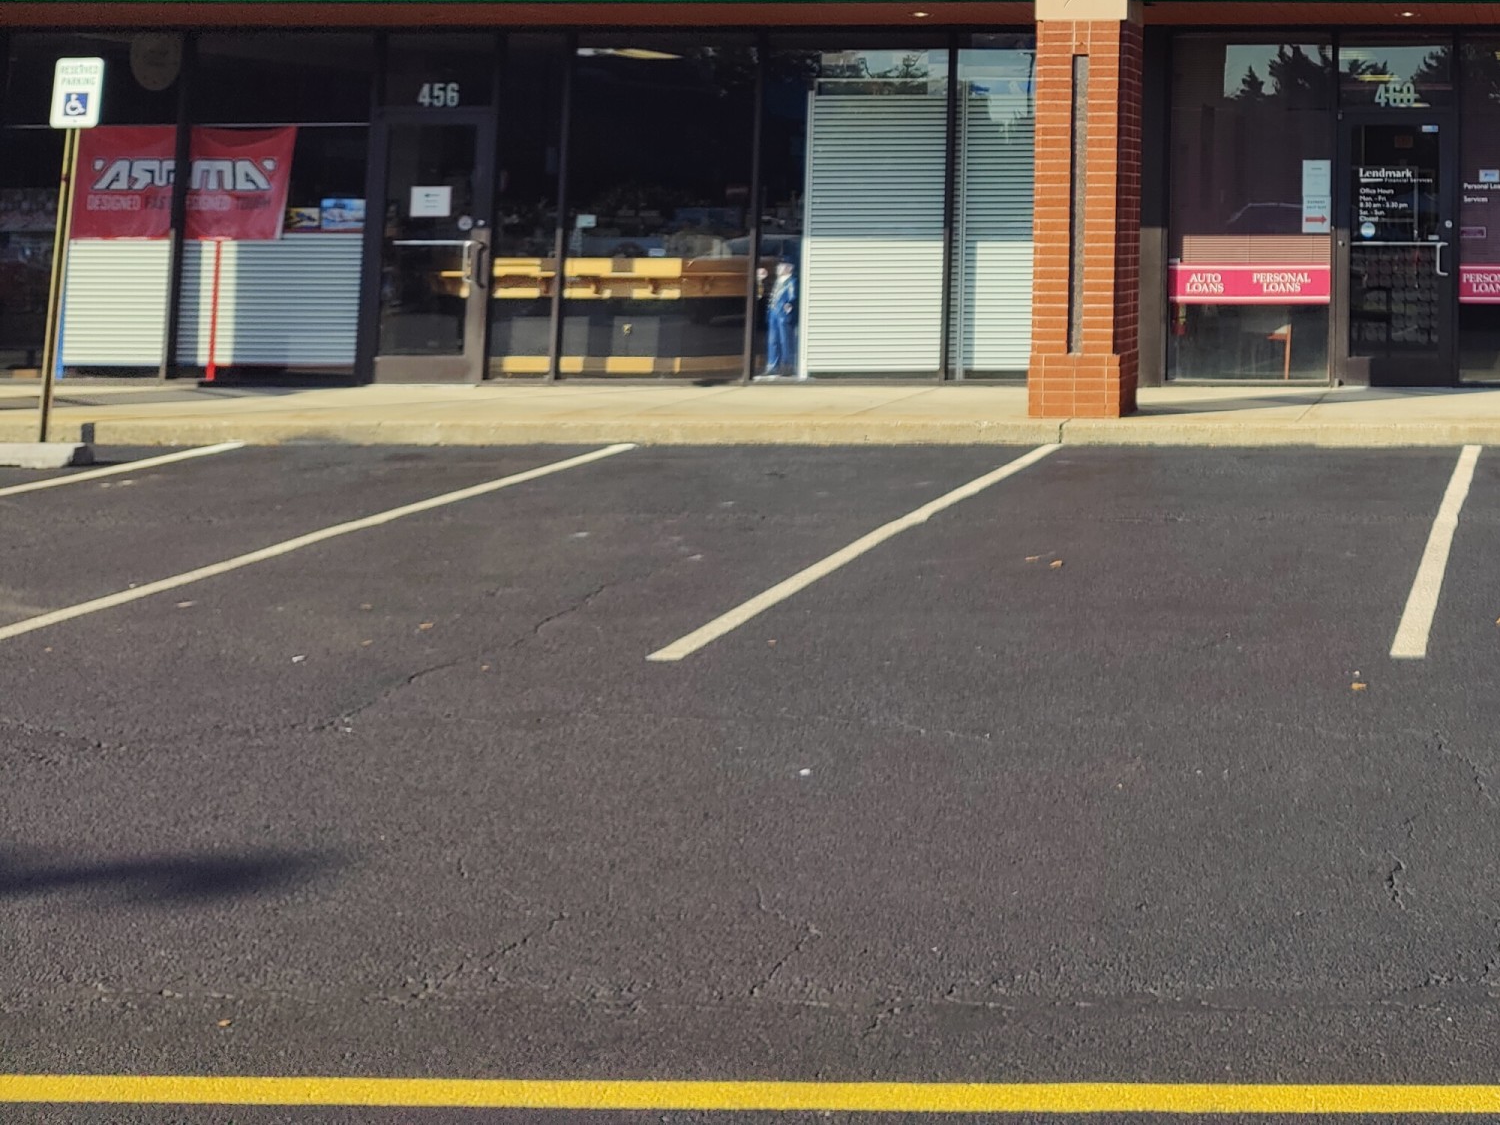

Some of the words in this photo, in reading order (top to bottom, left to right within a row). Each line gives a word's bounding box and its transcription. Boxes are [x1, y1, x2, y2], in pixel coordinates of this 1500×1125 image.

[417, 82, 460, 107] 456
[1359, 167, 1412, 178] Lendmark
[1189, 273, 1222, 283] AUTO
[1252, 272, 1311, 283] PERSONAL
[1185, 283, 1224, 293] LOANS
[1263, 283, 1301, 293] LOANS
